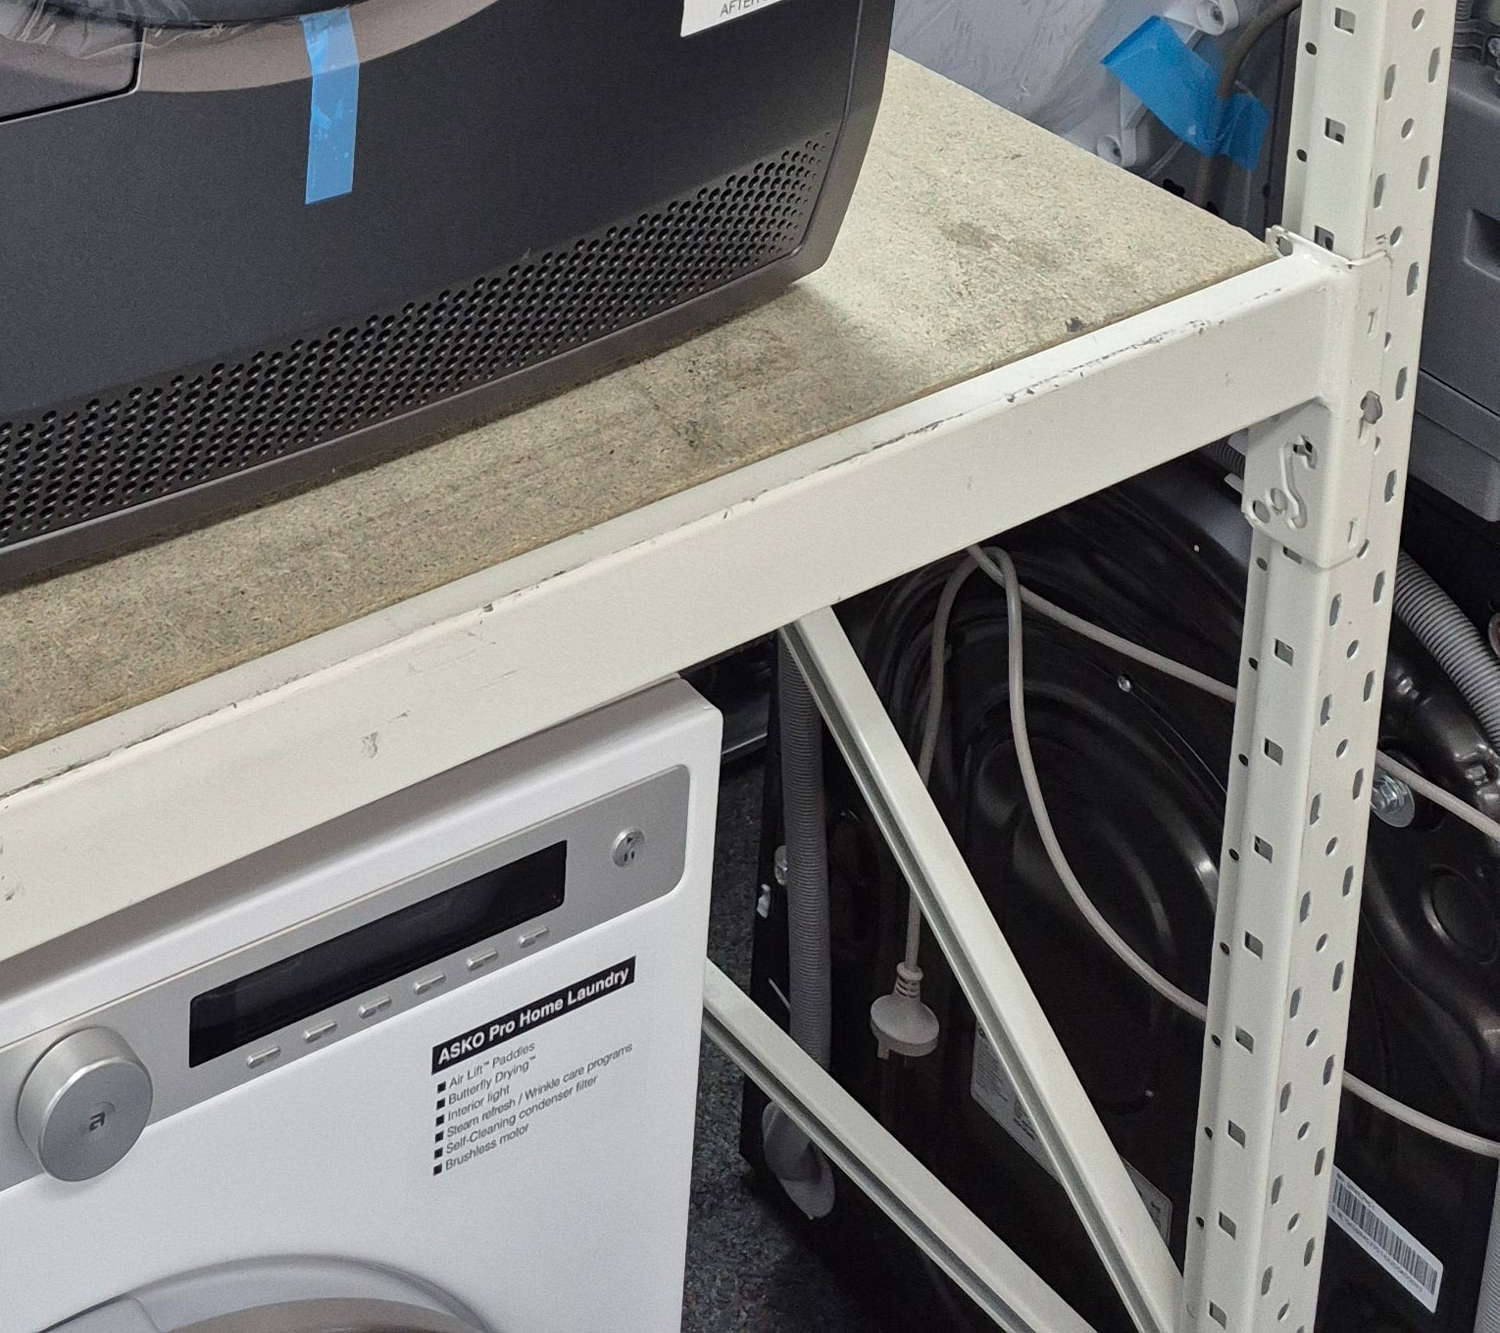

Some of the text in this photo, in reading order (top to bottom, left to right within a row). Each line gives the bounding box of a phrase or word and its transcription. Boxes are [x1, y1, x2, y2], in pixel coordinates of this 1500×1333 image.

[438, 965, 628, 1065] ASKO Pro Home Laundry
[448, 1073, 463, 1088] Air
[491, 1040, 534, 1068] Paddles
[446, 1113, 478, 1137] Steam
[482, 1097, 515, 1120] refresh
[525, 1076, 559, 1100] Wrinkle
[562, 1066, 584, 1083] care
[586, 1042, 632, 1073] programs
[447, 1084, 509, 1121] Interior light
[448, 1076, 492, 1106] Butterfly
[445, 1074, 597, 1154] Self-Cleaning condenser filter
[445, 1123, 529, 1170] Brushless motor
